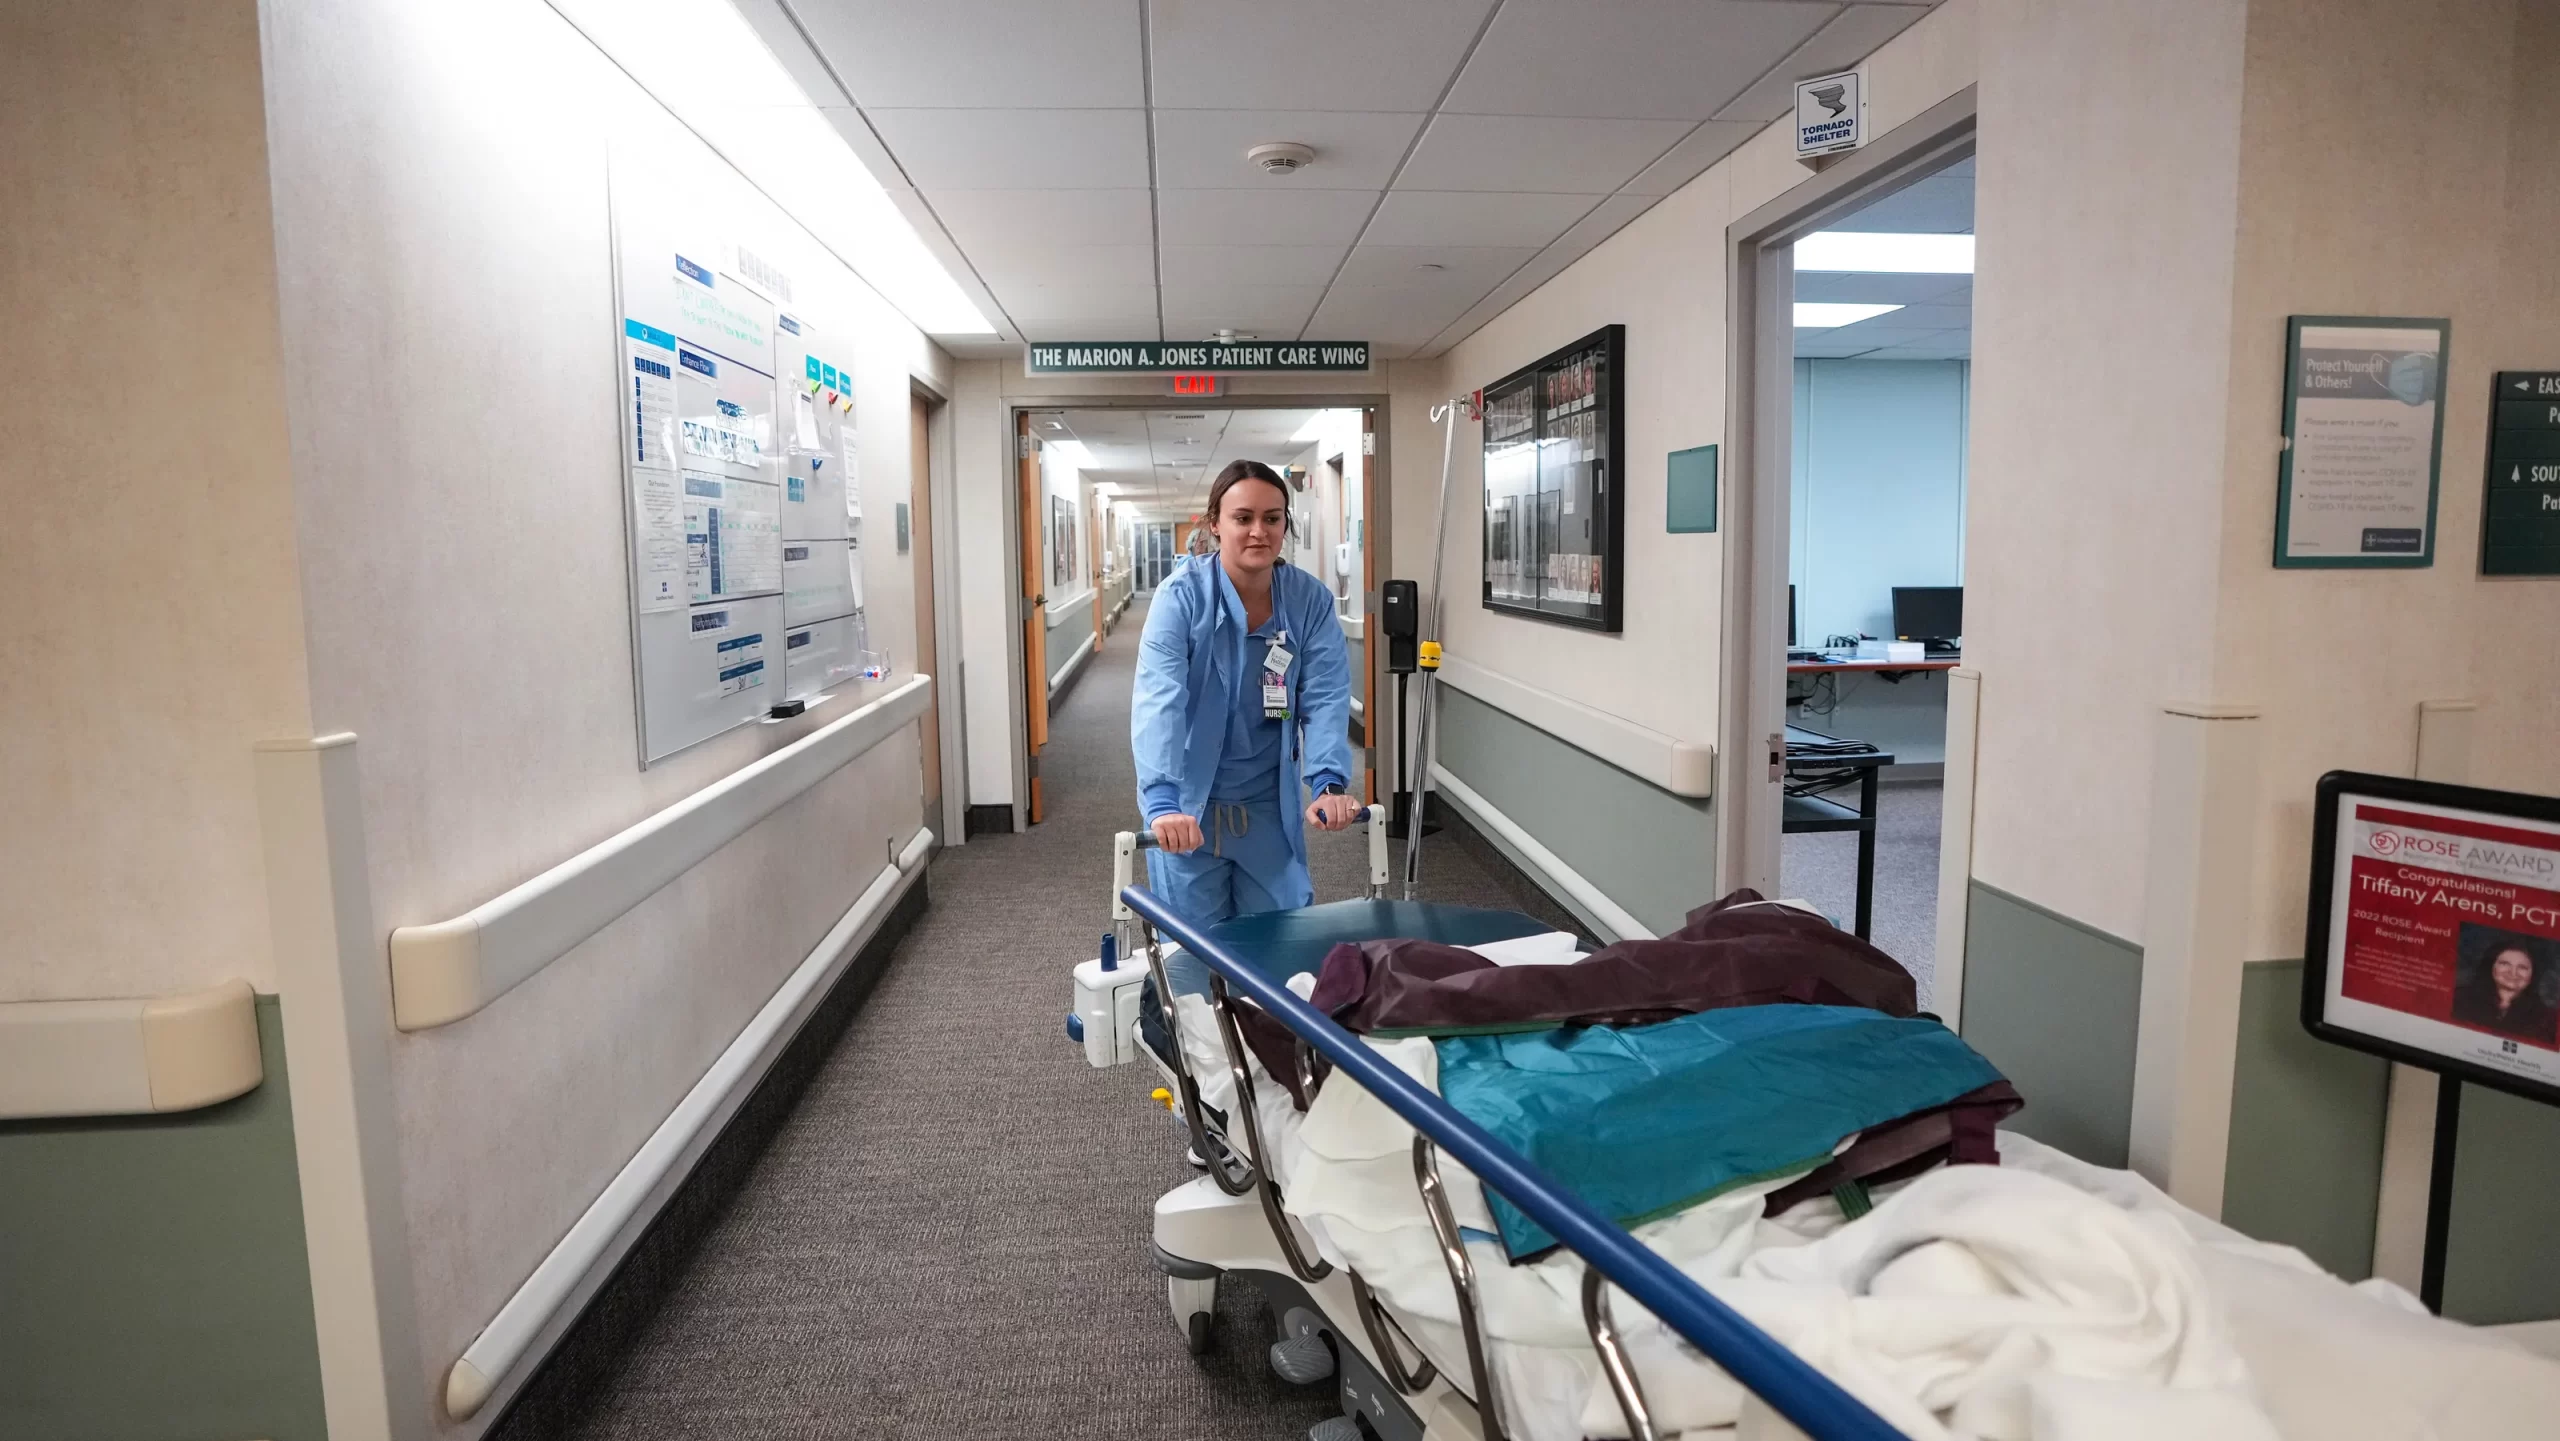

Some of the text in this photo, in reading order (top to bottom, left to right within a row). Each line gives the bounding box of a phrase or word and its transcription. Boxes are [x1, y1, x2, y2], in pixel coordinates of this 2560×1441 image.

[1802, 119, 1853, 135] TORNADO
[1803, 129, 1850, 144] SHELTER
[1033, 347, 1366, 366] THE MARION A. JONES PATIENT CARE WING
[2306, 359, 2383, 373] Protect Yourself
[2304, 375, 2352, 388] & Others!
[1265, 709, 1282, 718] NURS
[2404, 837, 2460, 859] ROSE
[2467, 847, 2554, 873] AWARD
[2398, 868, 2516, 900] Congratulations!
[2359, 874, 2560, 928] Tiffany Arens, PCT
[2353, 909, 2451, 937] 2022 ROSE Award
[2375, 927, 2425, 945] Recipient
